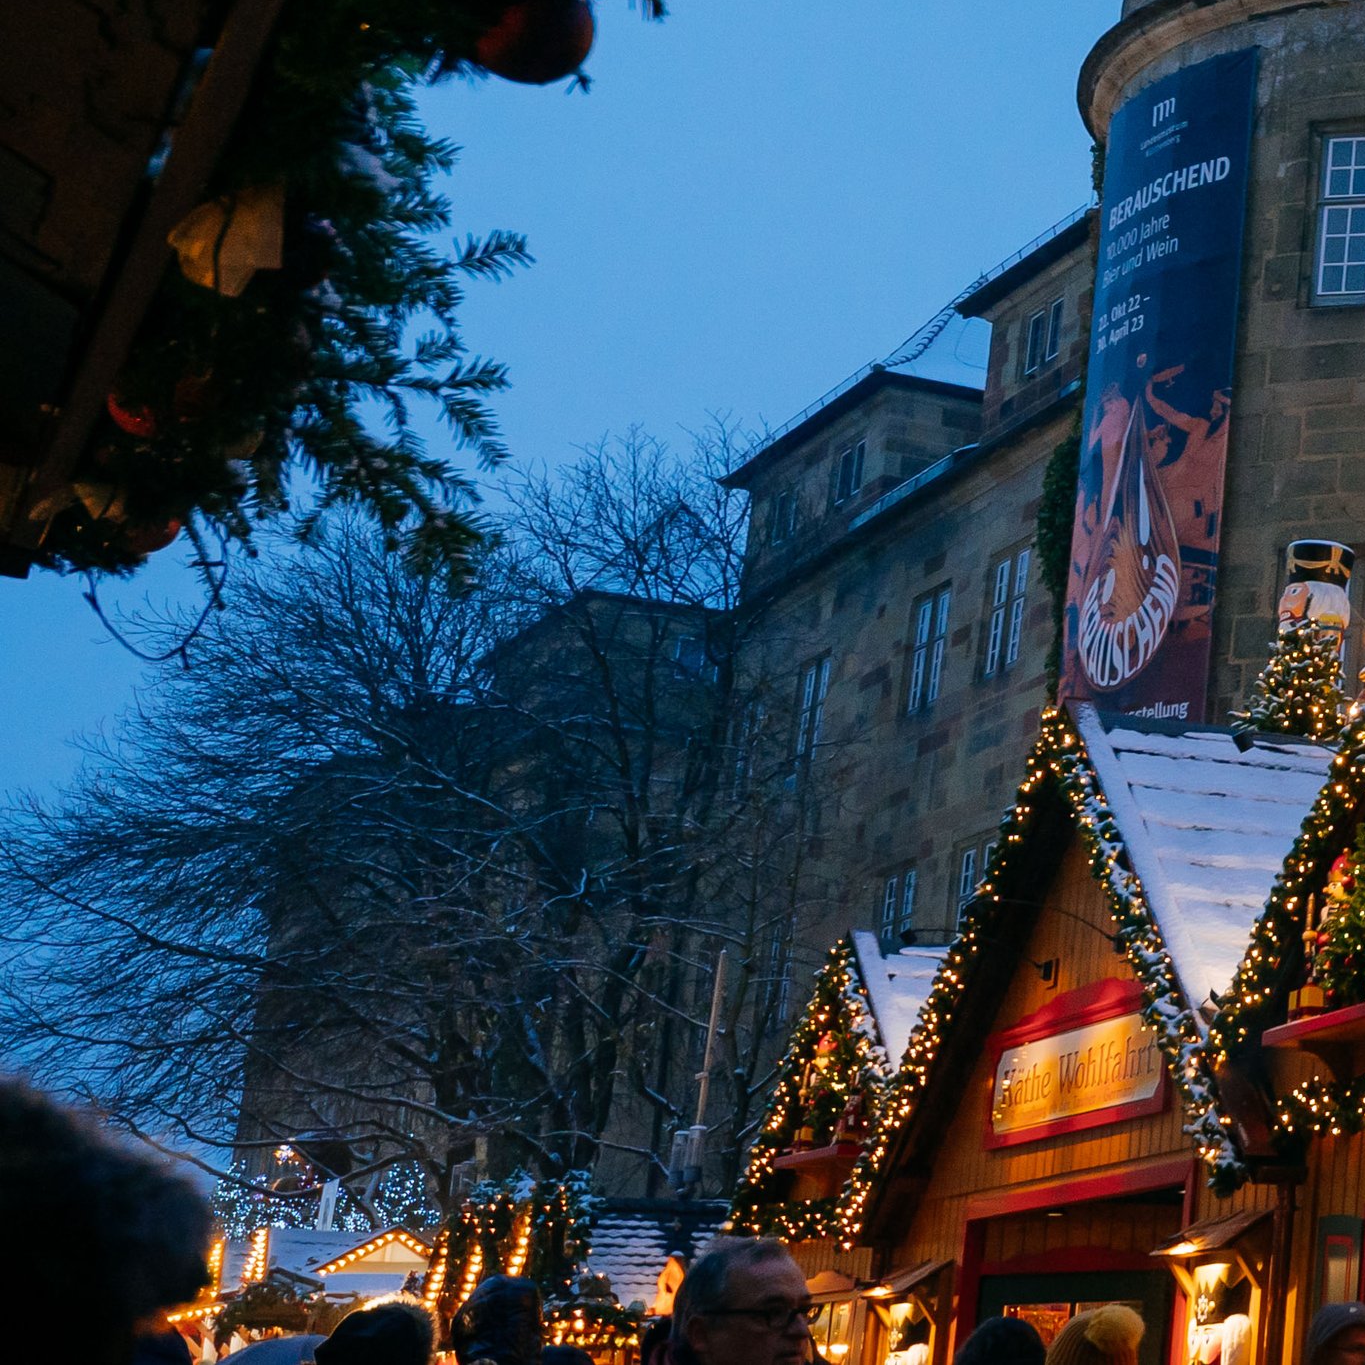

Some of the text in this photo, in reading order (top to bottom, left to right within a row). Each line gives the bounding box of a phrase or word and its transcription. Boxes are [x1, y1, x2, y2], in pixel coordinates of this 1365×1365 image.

[1109, 156, 1231, 231] BERAUSCHEND
[1102, 235, 1179, 289] Bier und Wein
[1106, 214, 1170, 260] 10.000 Jahre
[1108, 321, 1129, 346] April
[1131, 314, 1145, 333] 23
[1111, 301, 1127, 322] Okt
[1127, 294, 1141, 313] 22
[1078, 554, 1178, 687] BERAUSCHEND
[1001, 1062, 1051, 1109] Käthe
[1059, 1035, 1157, 1095] Wohlfahrt
